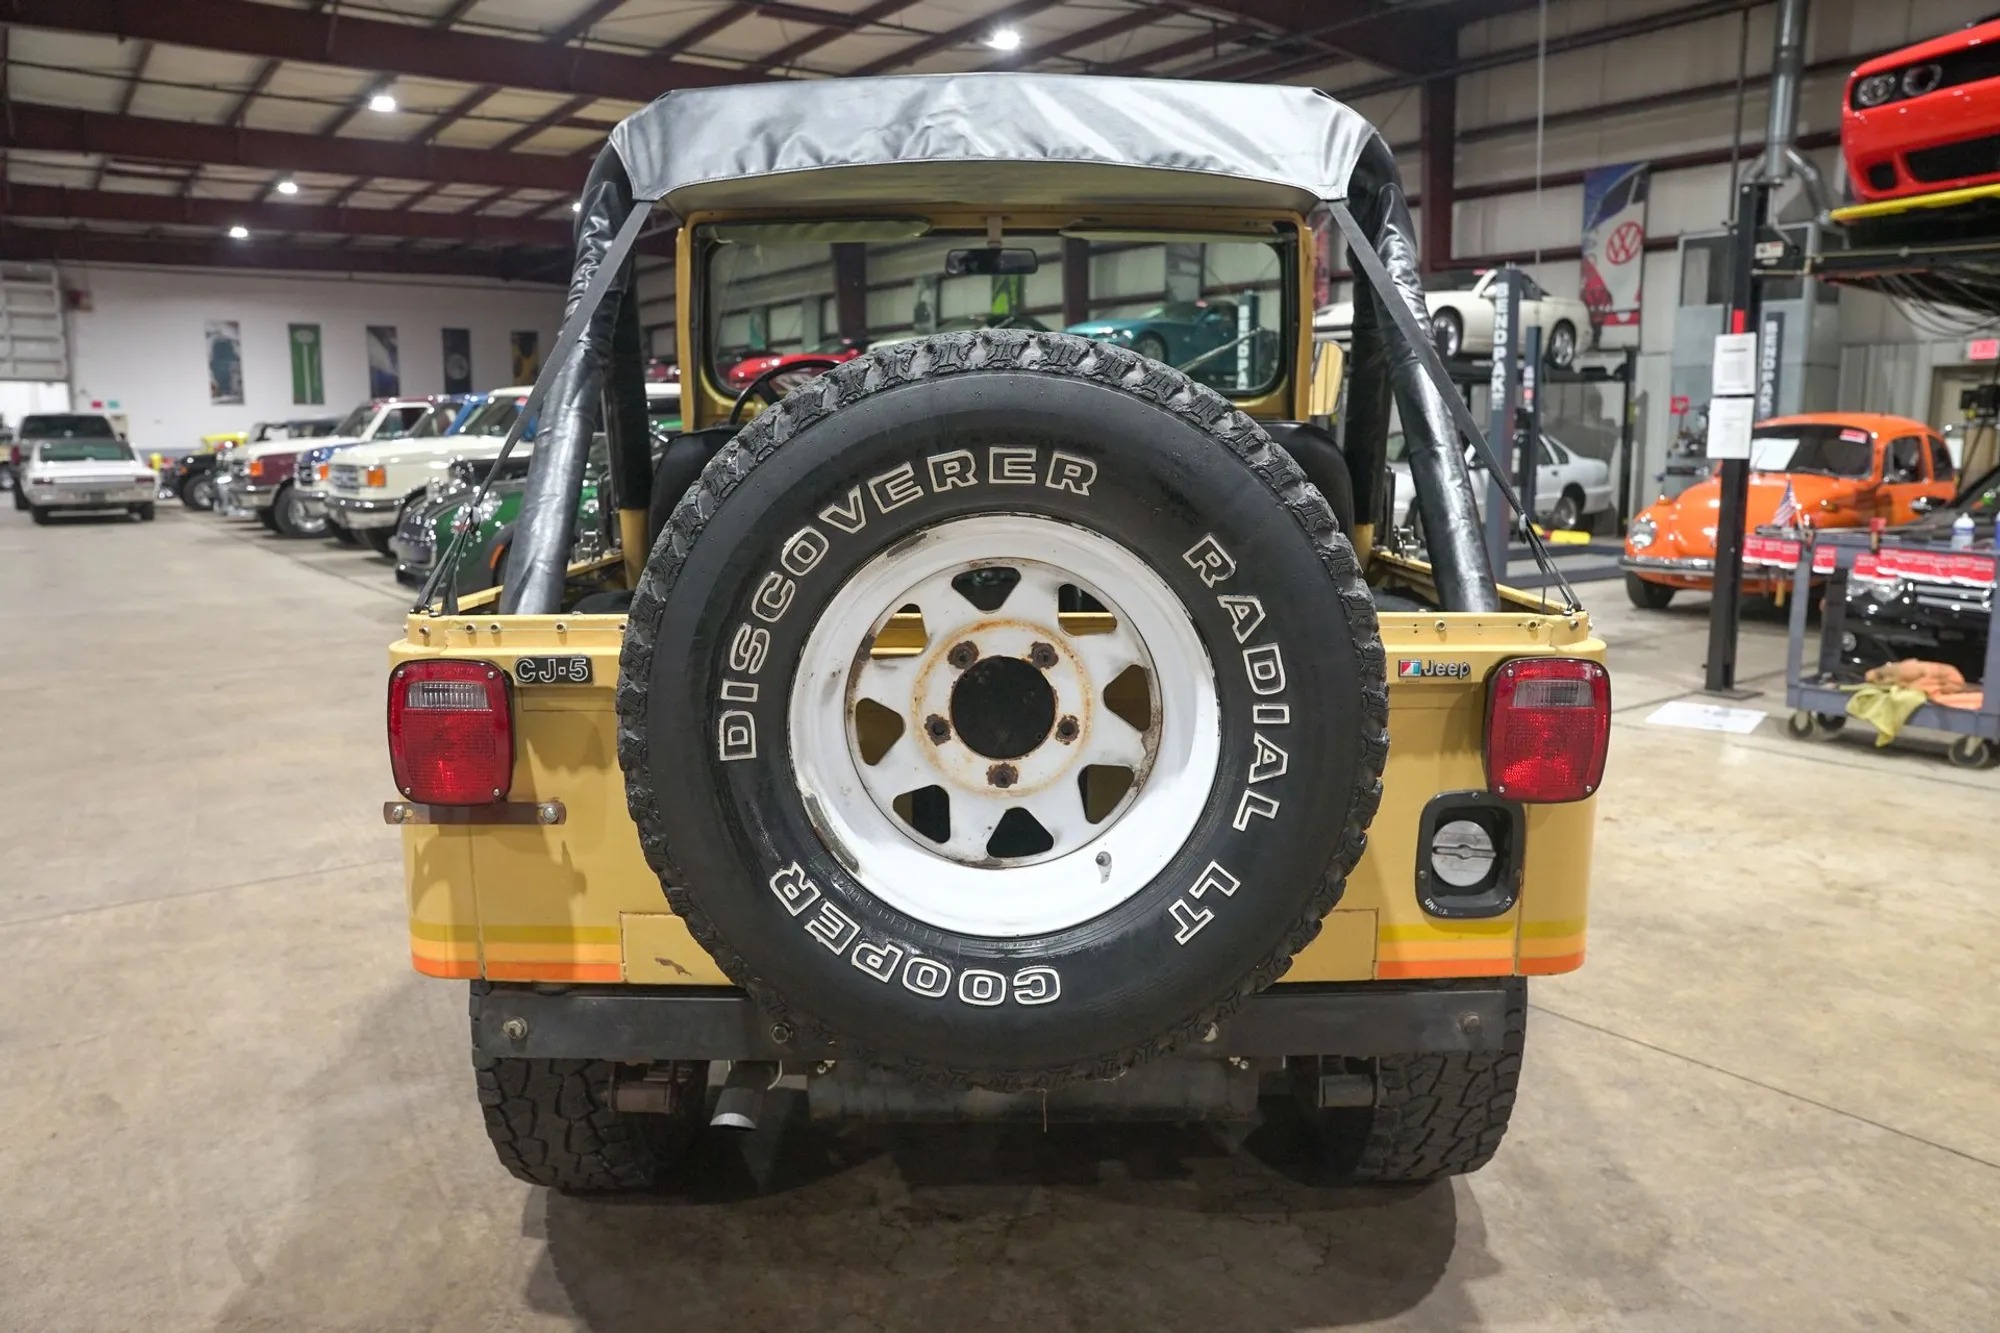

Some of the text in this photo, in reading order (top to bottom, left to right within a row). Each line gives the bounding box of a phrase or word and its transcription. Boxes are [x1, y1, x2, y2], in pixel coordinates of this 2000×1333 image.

[515, 657, 589, 683] CJ-5
[719, 447, 1291, 947] DISCOVERER RADIAL LT
[1423, 660, 1471, 680] Jeep
[769, 861, 1062, 1007] COOPER
